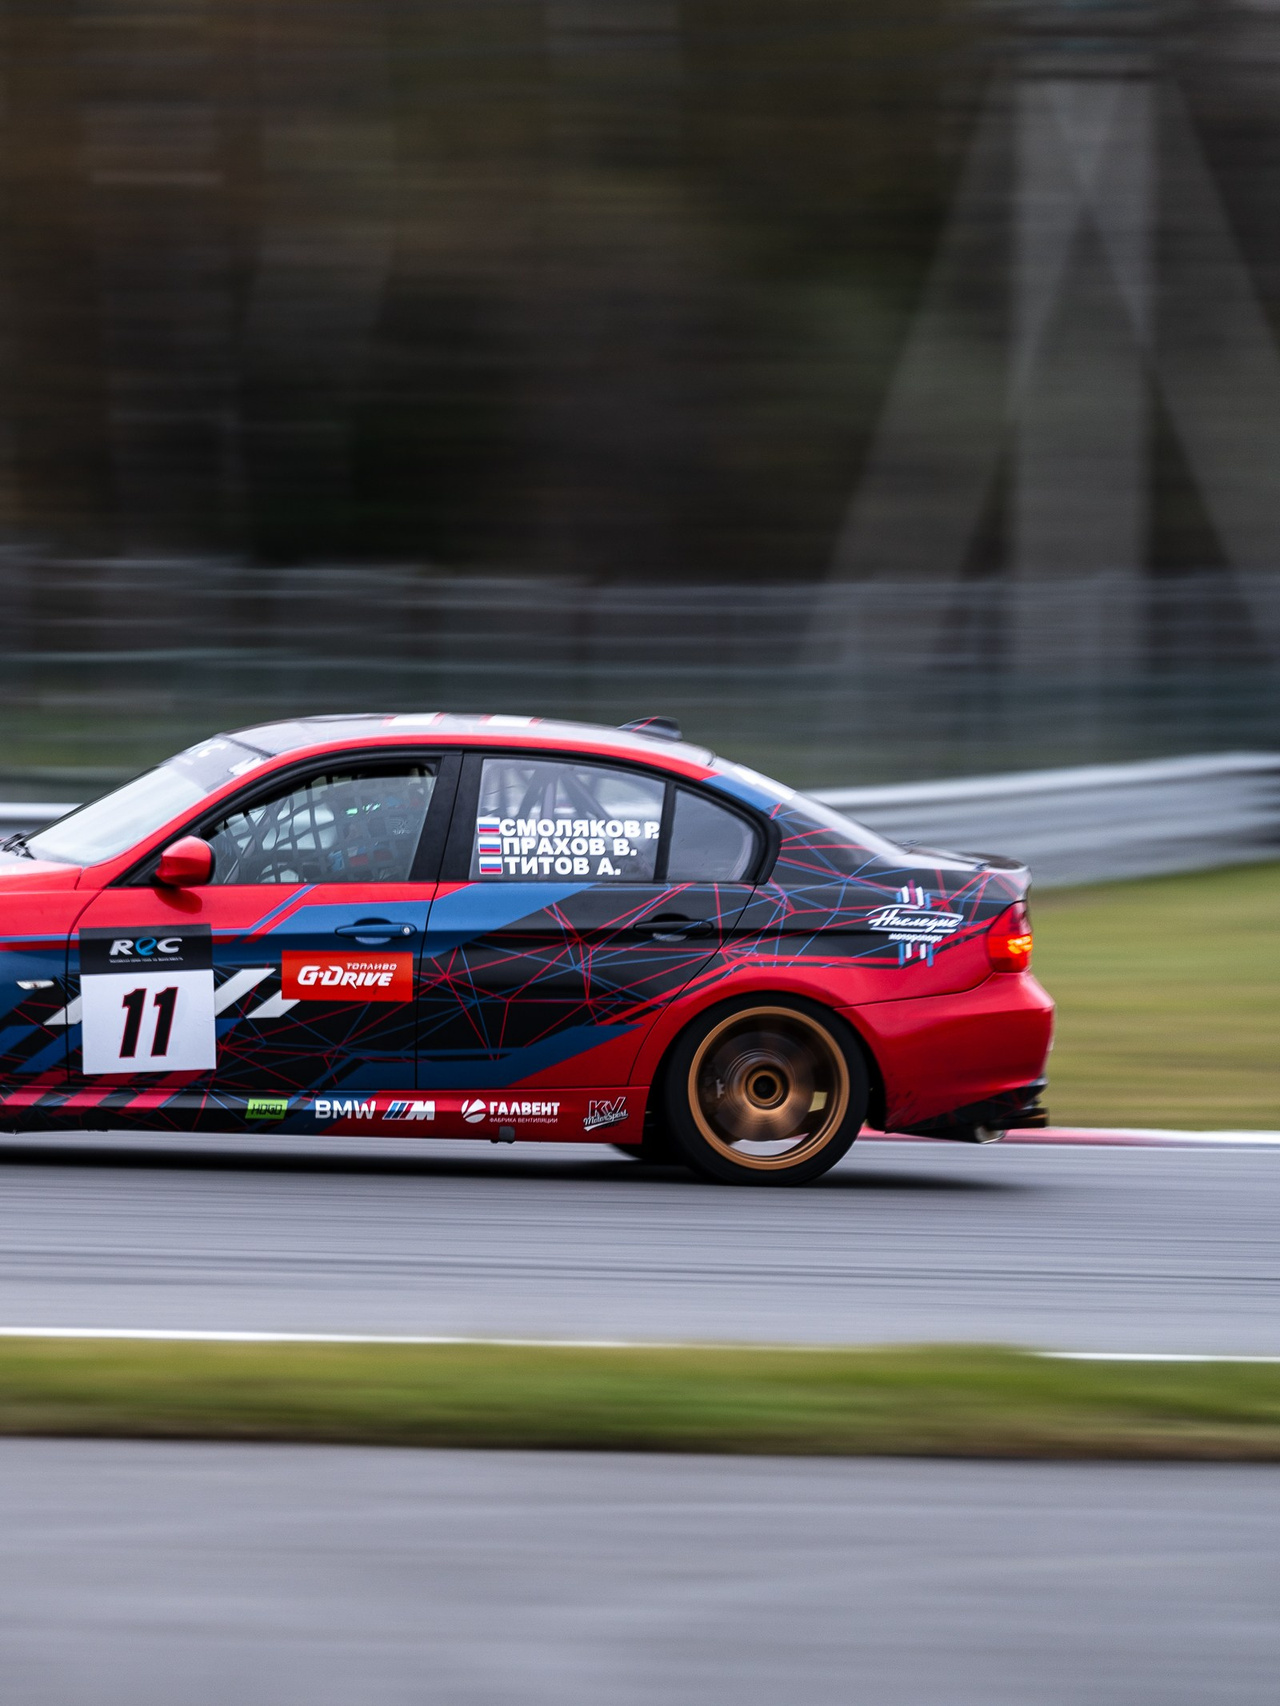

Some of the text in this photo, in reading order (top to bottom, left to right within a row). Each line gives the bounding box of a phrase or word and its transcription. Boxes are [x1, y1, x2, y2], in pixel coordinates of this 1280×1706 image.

[500, 819, 641, 838] СМОЛЯКОВ
[503, 838, 638, 857] ПРАХОВ В.
[504, 857, 622, 876] ТИТОВ А.
[346, 962, 398, 971] ТОПЛИВО
[119, 987, 179, 1058] 11
[314, 1100, 377, 1120] BMW
[489, 1101, 560, 1116] ГАЛВЕНТ
